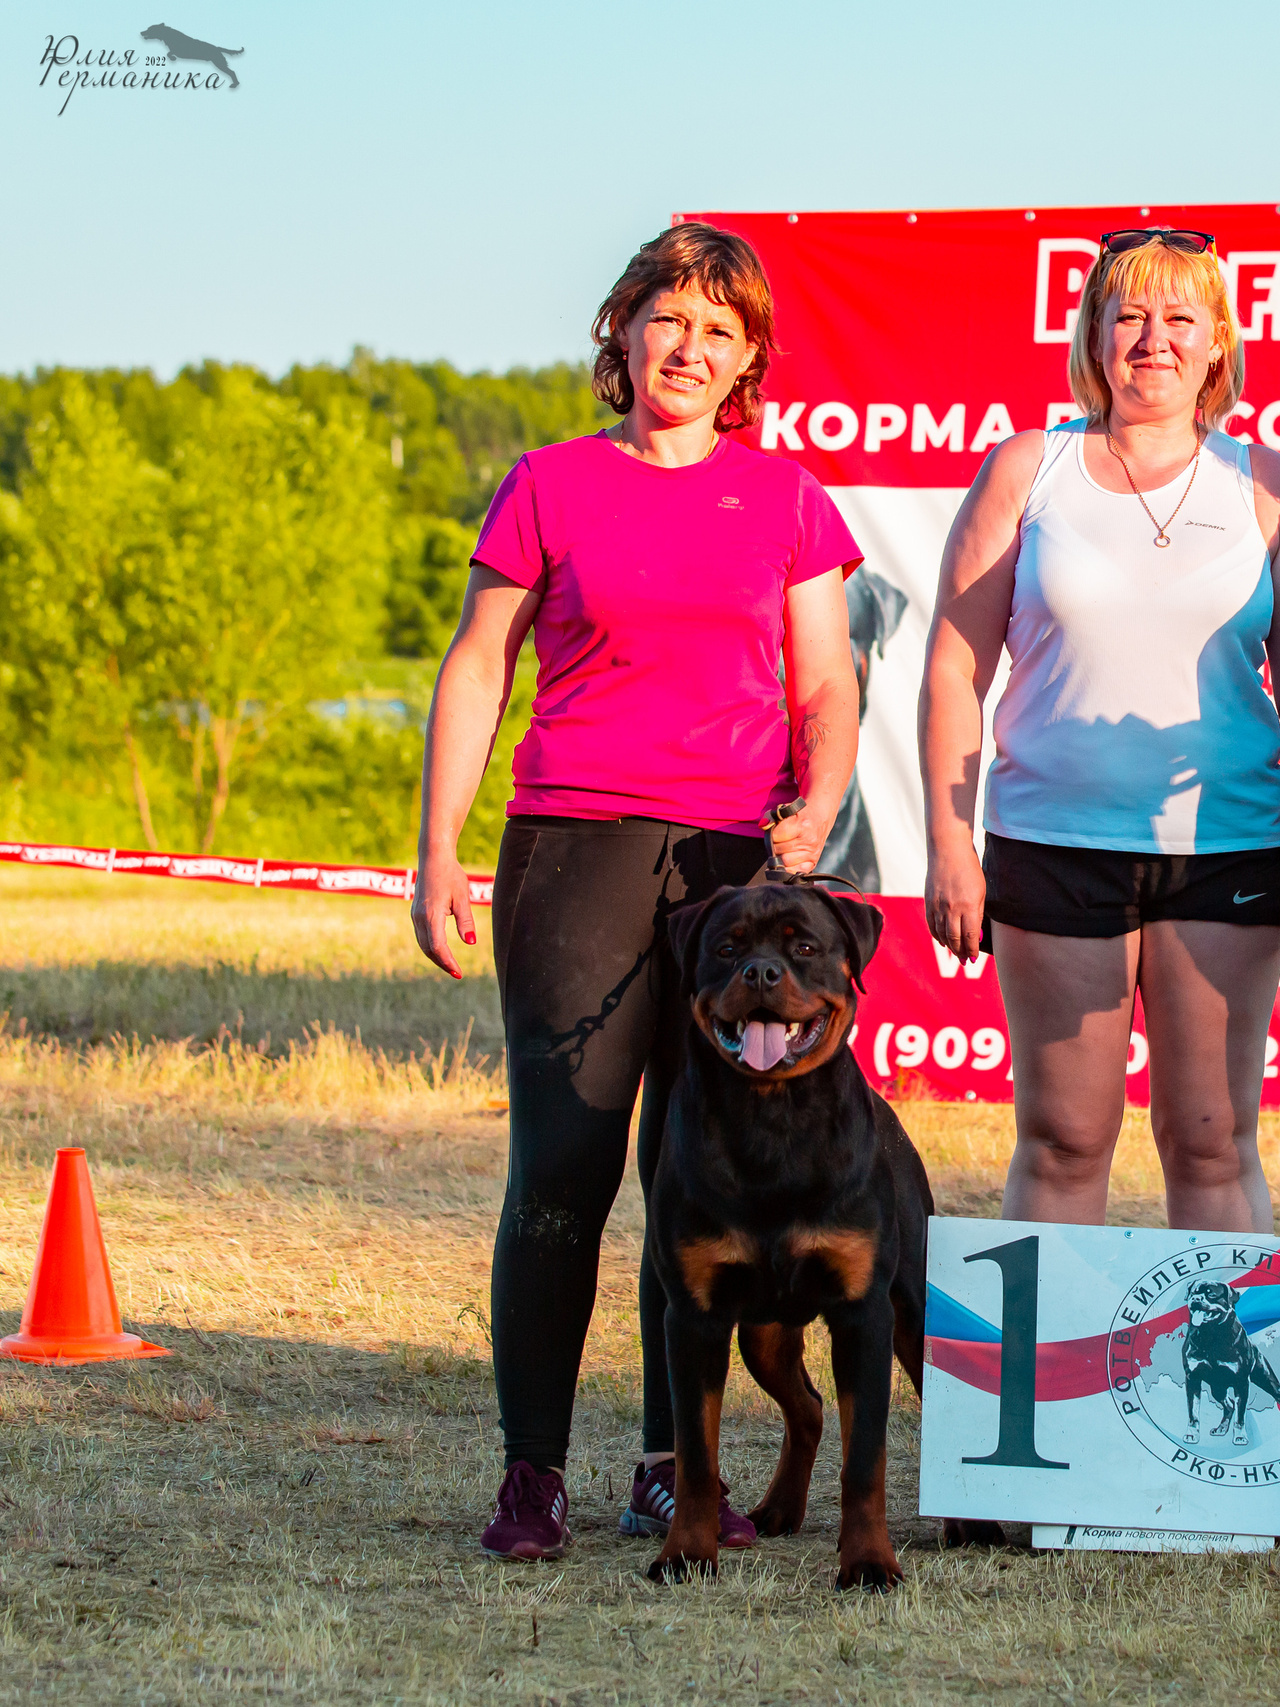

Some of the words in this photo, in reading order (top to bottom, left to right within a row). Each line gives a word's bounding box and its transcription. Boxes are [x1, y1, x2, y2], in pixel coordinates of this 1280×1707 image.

[760, 401, 1014, 453] КОРМА
[1194, 522, 1226, 531] DEMIX
[874, 1022, 1013, 1080] (909
[961, 1235, 1070, 1470] 1
[1112, 1251, 1212, 1416] РОТВЕЙЛЕР
[1082, 1527, 1122, 1539] Корма
[1125, 1531, 1165, 1540] нового
[1168, 1532, 1229, 1543] поколения
